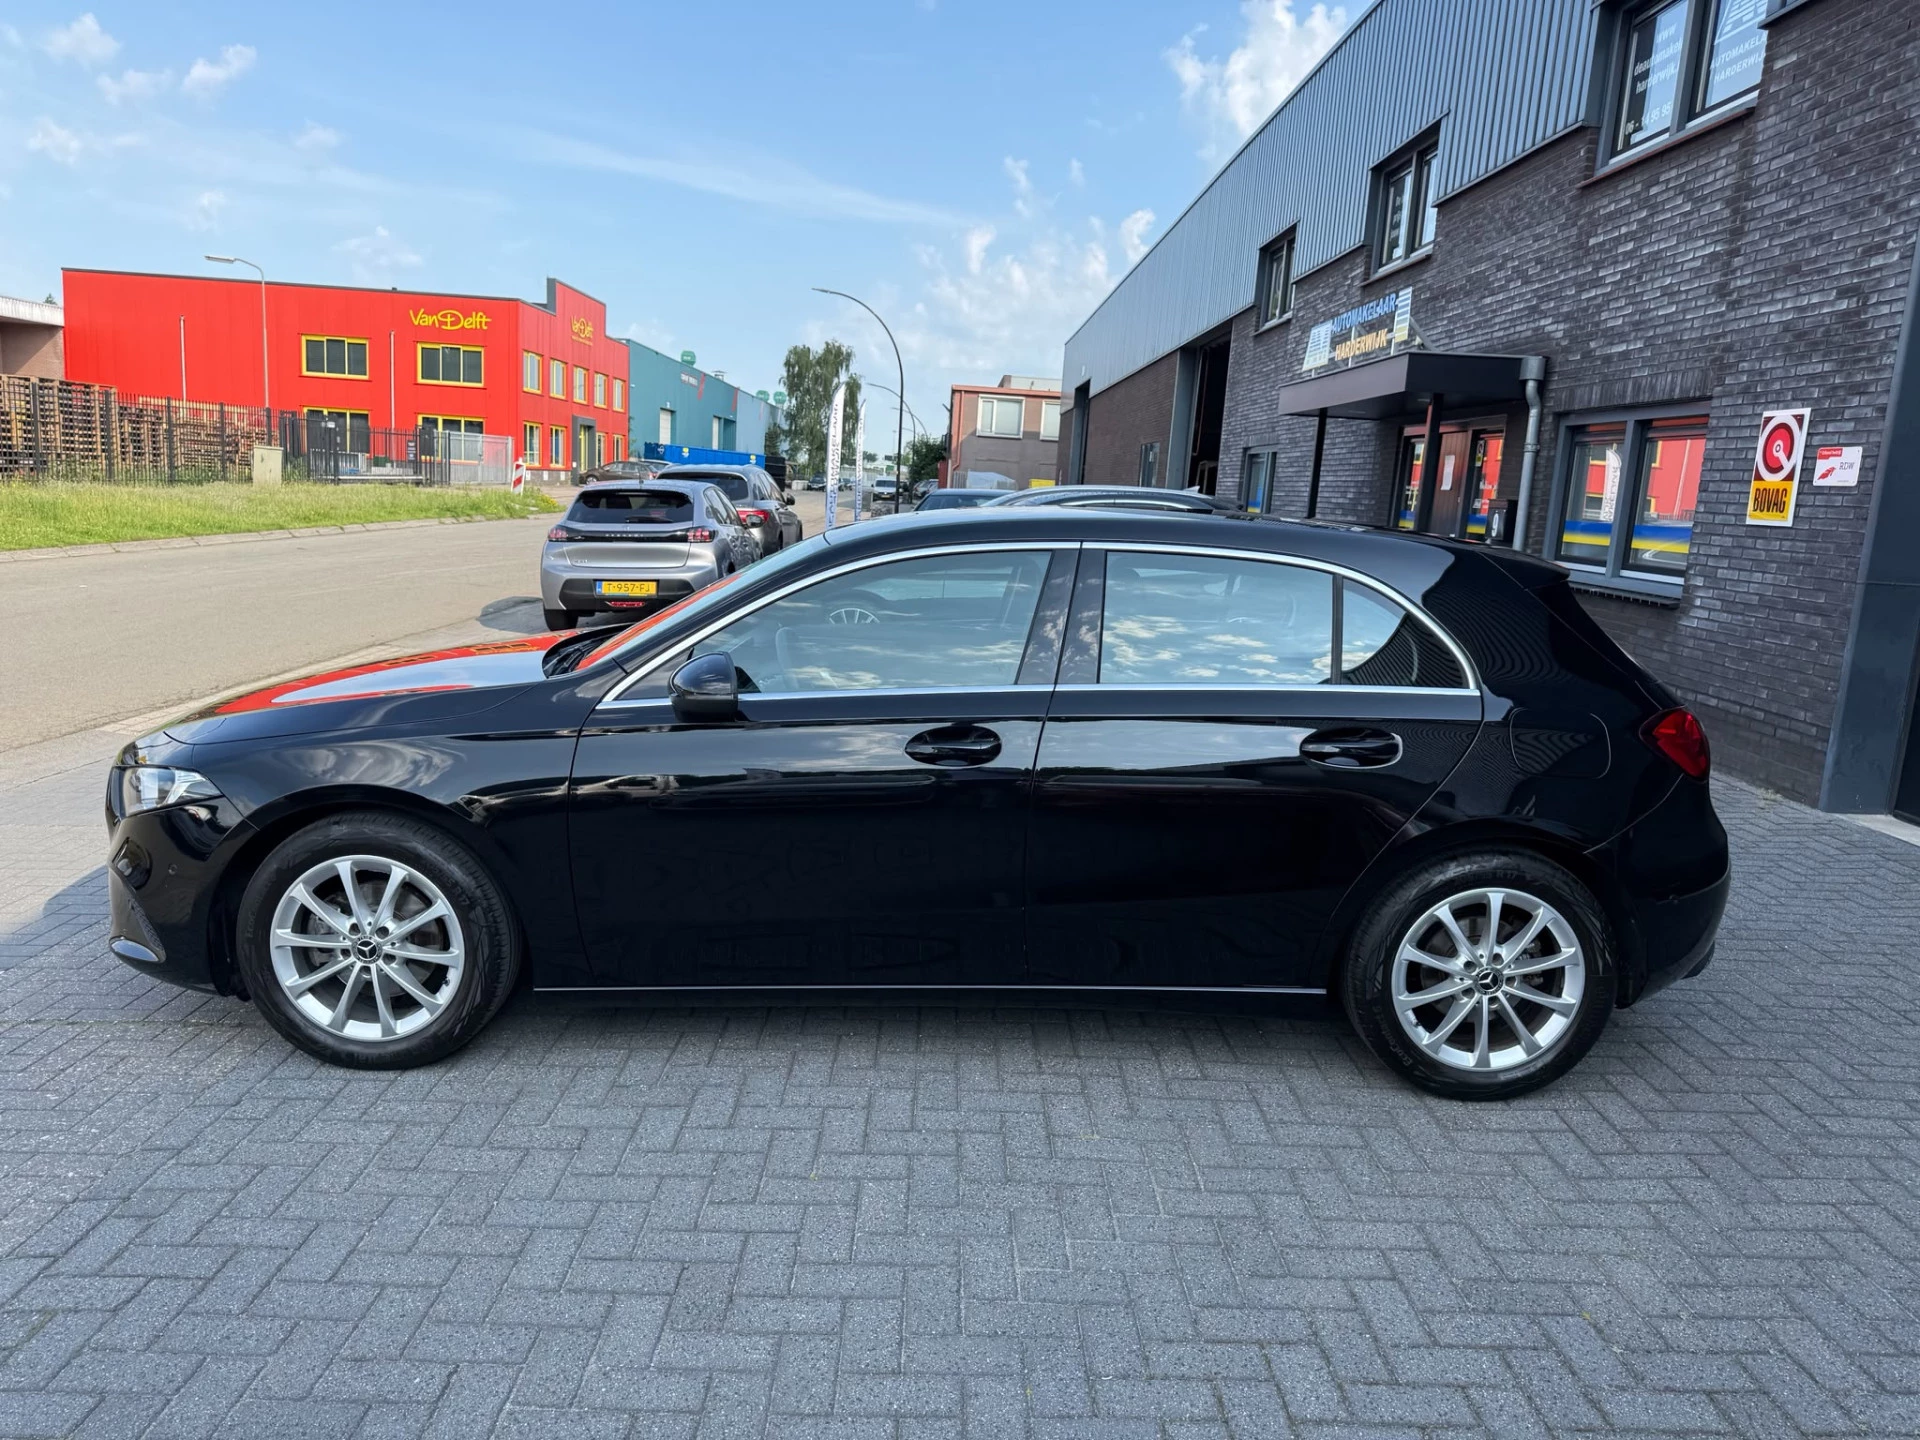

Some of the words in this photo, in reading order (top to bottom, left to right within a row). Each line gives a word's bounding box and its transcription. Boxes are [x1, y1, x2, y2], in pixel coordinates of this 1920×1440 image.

[1331, 293, 1397, 334] AUTOMAKELAAR
[1335, 328, 1388, 361] HARDERWIJK
[1752, 487, 1788, 514] BOVAG
[1491, 513, 1499, 537] 9
[607, 583, 650, 592] T-957-FJ
